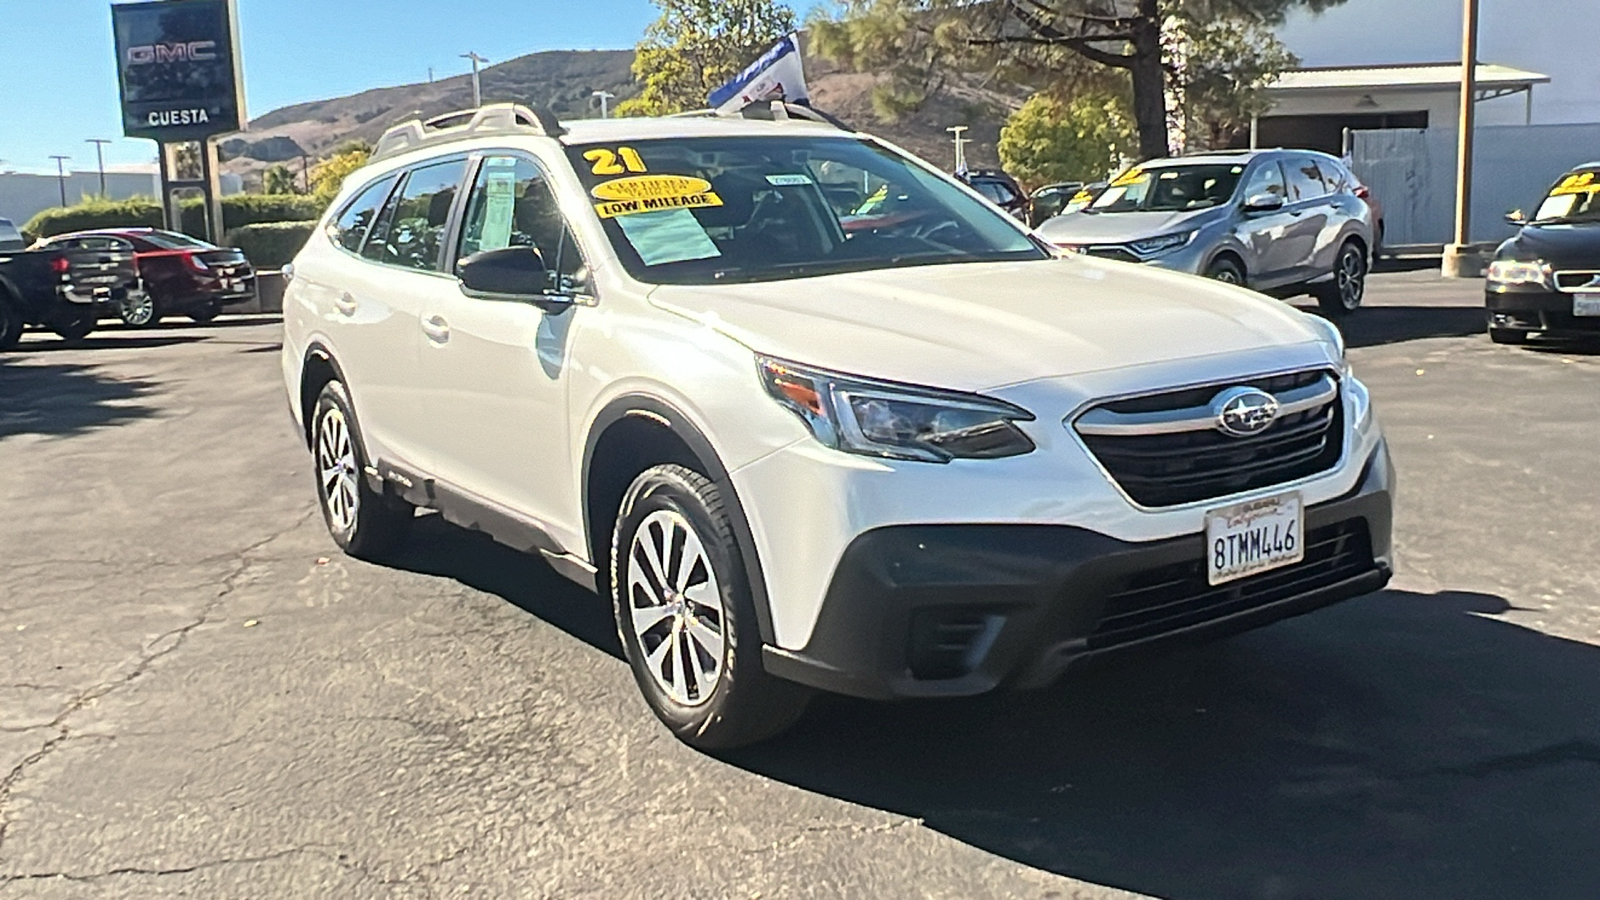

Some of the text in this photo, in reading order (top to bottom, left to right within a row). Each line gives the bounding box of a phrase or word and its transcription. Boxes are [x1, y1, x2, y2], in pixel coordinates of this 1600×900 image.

[128, 41, 217, 65] GMC
[148, 108, 210, 126] CUESTA
[583, 146, 648, 175] 21
[603, 193, 713, 216] LOW MILEAGE
[1214, 519, 1295, 570] 8TMM446
